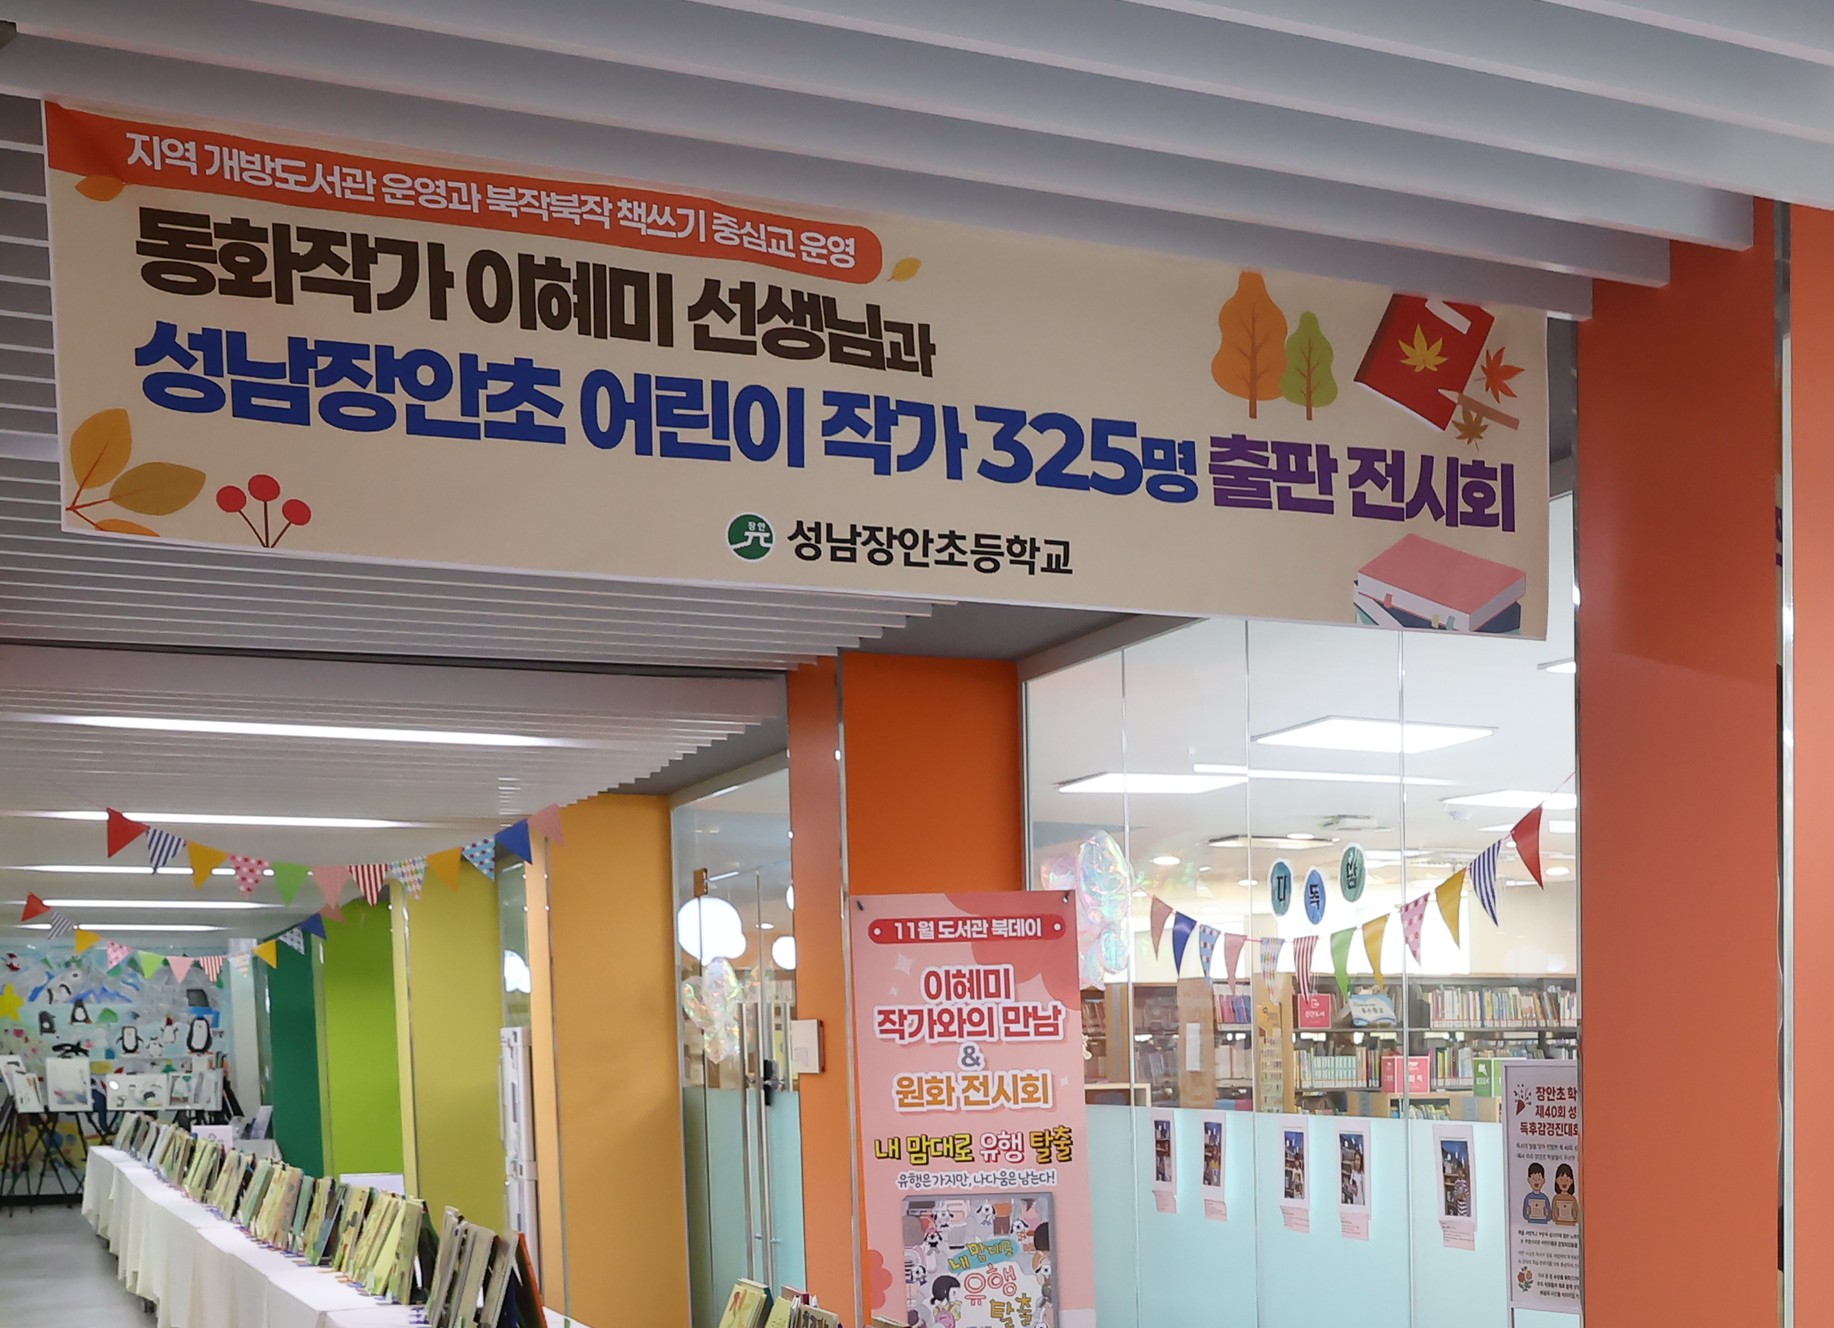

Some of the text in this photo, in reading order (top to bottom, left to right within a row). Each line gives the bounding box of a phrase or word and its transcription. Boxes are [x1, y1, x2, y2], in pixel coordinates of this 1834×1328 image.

[125, 131, 857, 269] 지역 개방도서관 운영과 북작북작 책쓰기 중심교 운영
[136, 207, 936, 377] 동화작가 이혜미 선생님과
[134, 320, 1516, 533] 성남장안초 어린이 작가 325명 출판 전시회
[787, 520, 1073, 576] 성남장안초등학교
[894, 918, 1042, 941] 11월 도서관 북데이
[924, 968, 1011, 1002] 이혜미
[878, 1005, 1061, 1039] 작가와의 만남
[961, 1046, 983, 1068] &
[895, 1072, 1050, 1109] 원화 전시회
[1535, 1086, 1567, 1101] 장안초
[1535, 1105, 1566, 1119] 제40회
[874, 1125, 1074, 1165] 내 맘대로 유행 탈출
[964, 1262, 1017, 1306] 유행
